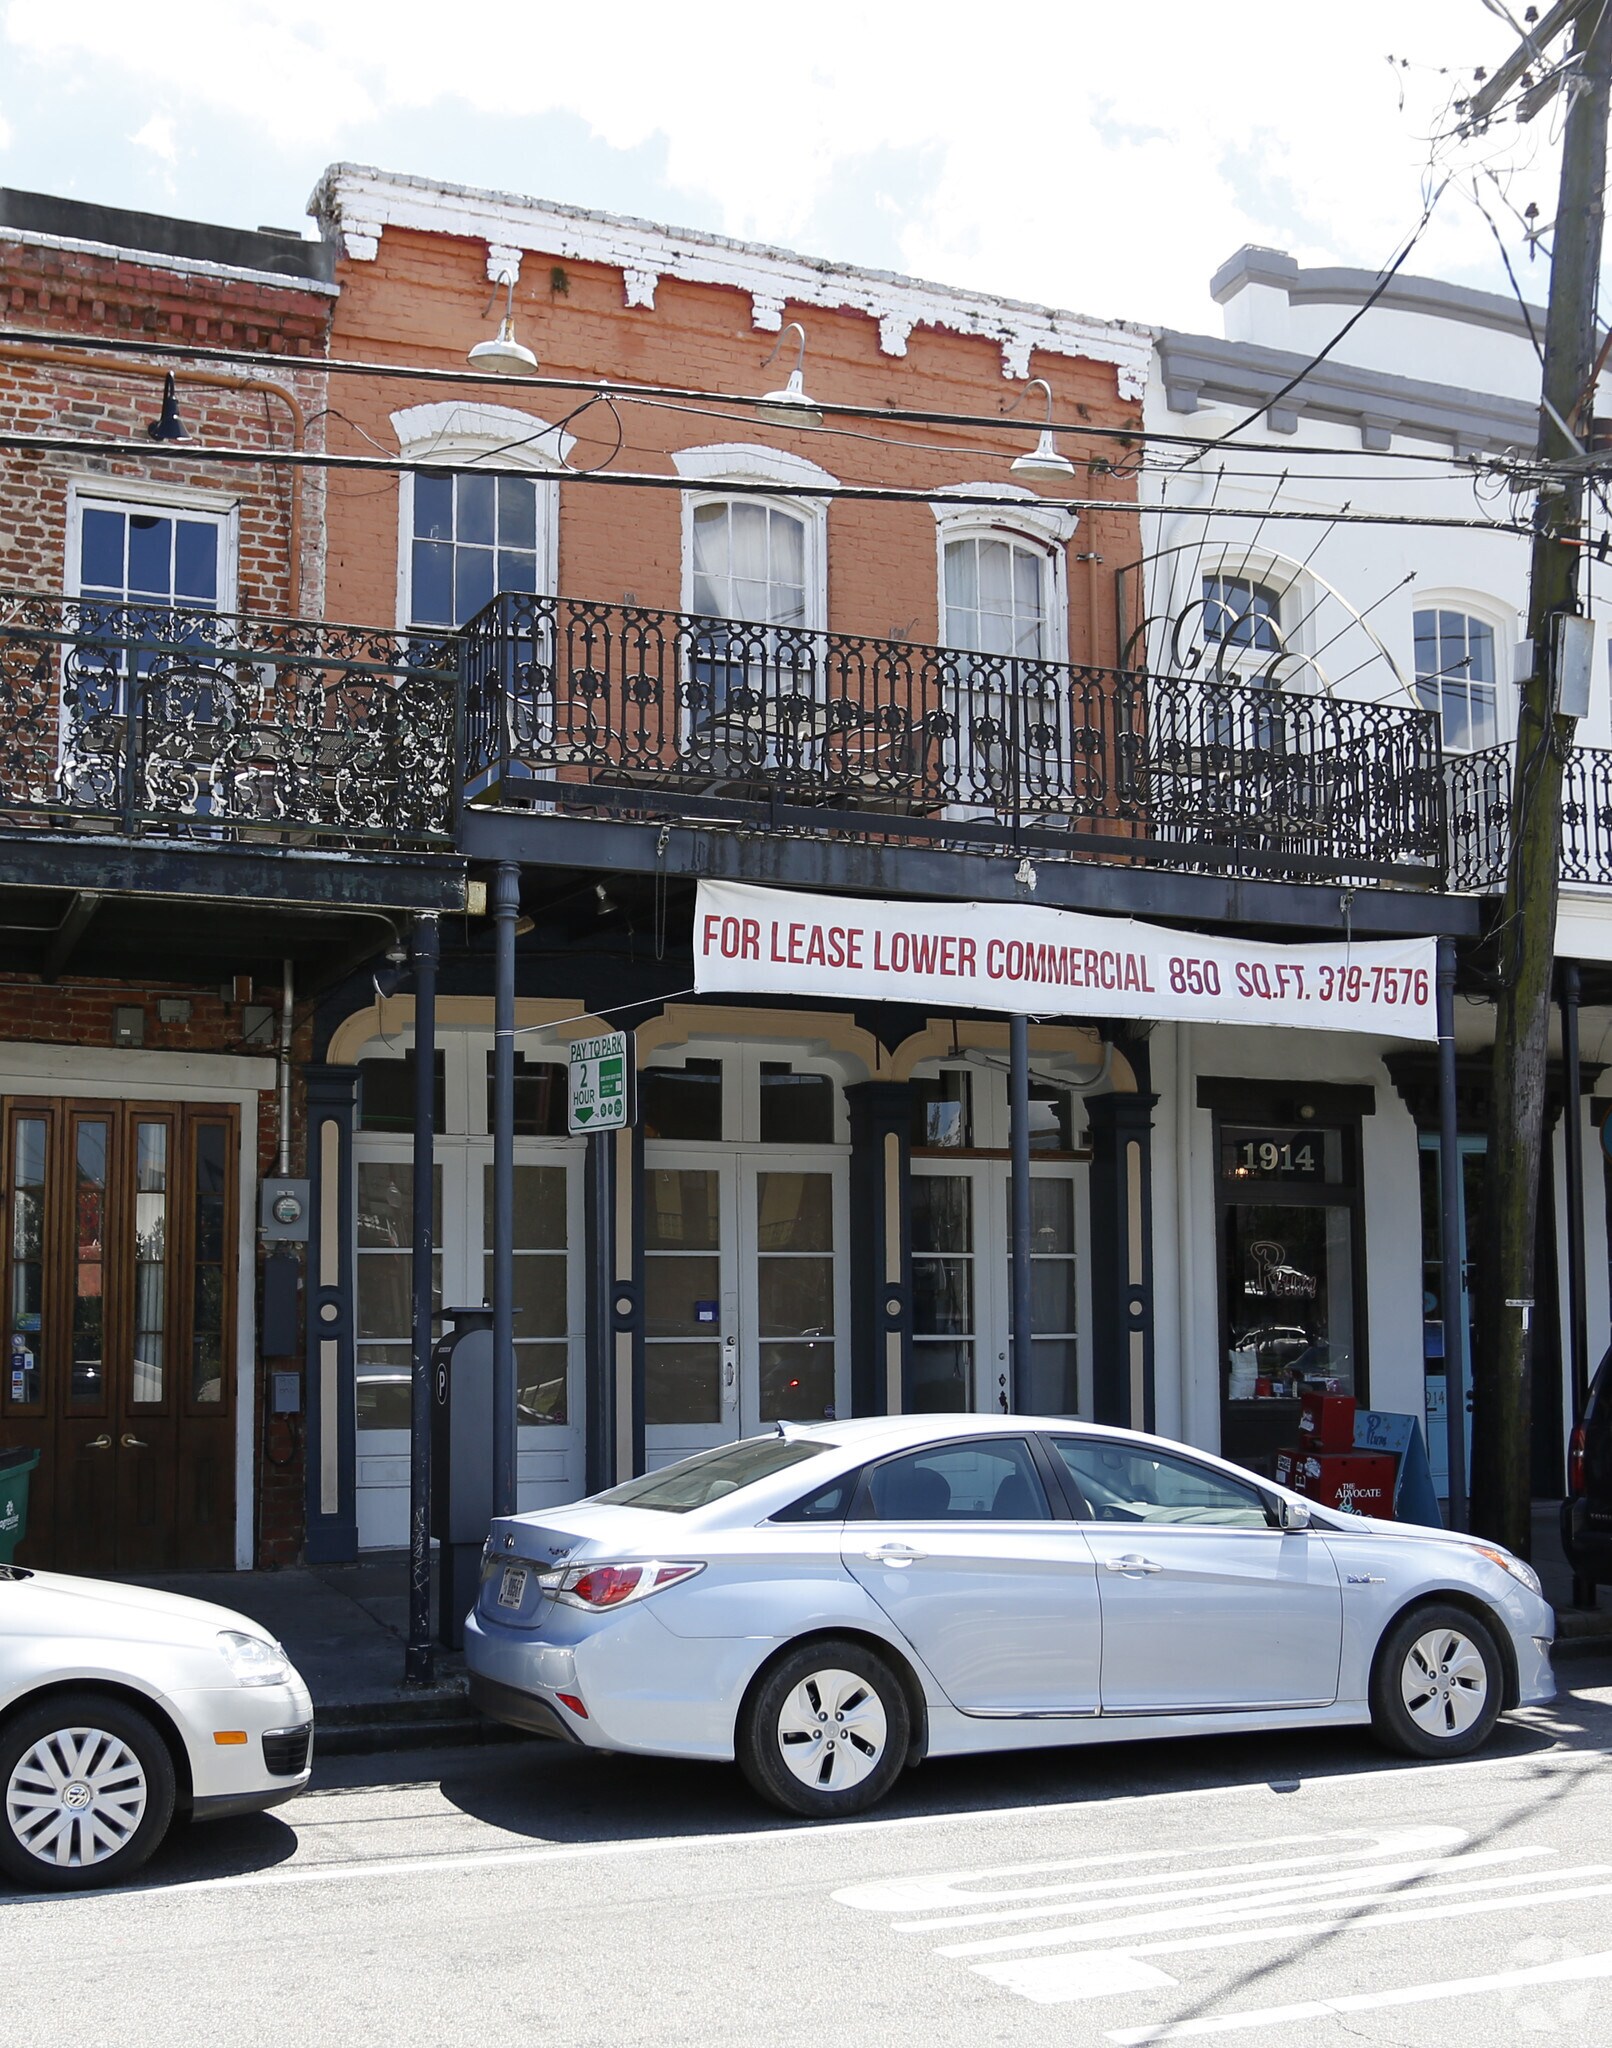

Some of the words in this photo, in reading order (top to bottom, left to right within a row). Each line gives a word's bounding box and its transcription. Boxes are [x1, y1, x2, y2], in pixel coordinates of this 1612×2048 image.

[703, 915, 760, 960] FOR
[770, 921, 864, 969] LEASE
[874, 931, 976, 978] LOWER
[986, 938, 1155, 993] COMMERCIAL
[1168, 957, 1222, 996] 850
[1318, 965, 1429, 1006] 319-7576
[571, 1043, 587, 1061] PAY
[589, 1040, 600, 1057] TO
[602, 1034, 624, 1055] PARK
[580, 1063, 588, 1088] 2
[573, 1089, 595, 1106] HOUR
[1243, 1142, 1315, 1171] 1914
[439, 1371, 446, 1397] P
[1335, 1487, 1381, 1499] ADVOCATE
[1342, 1482, 1356, 1490] THE
